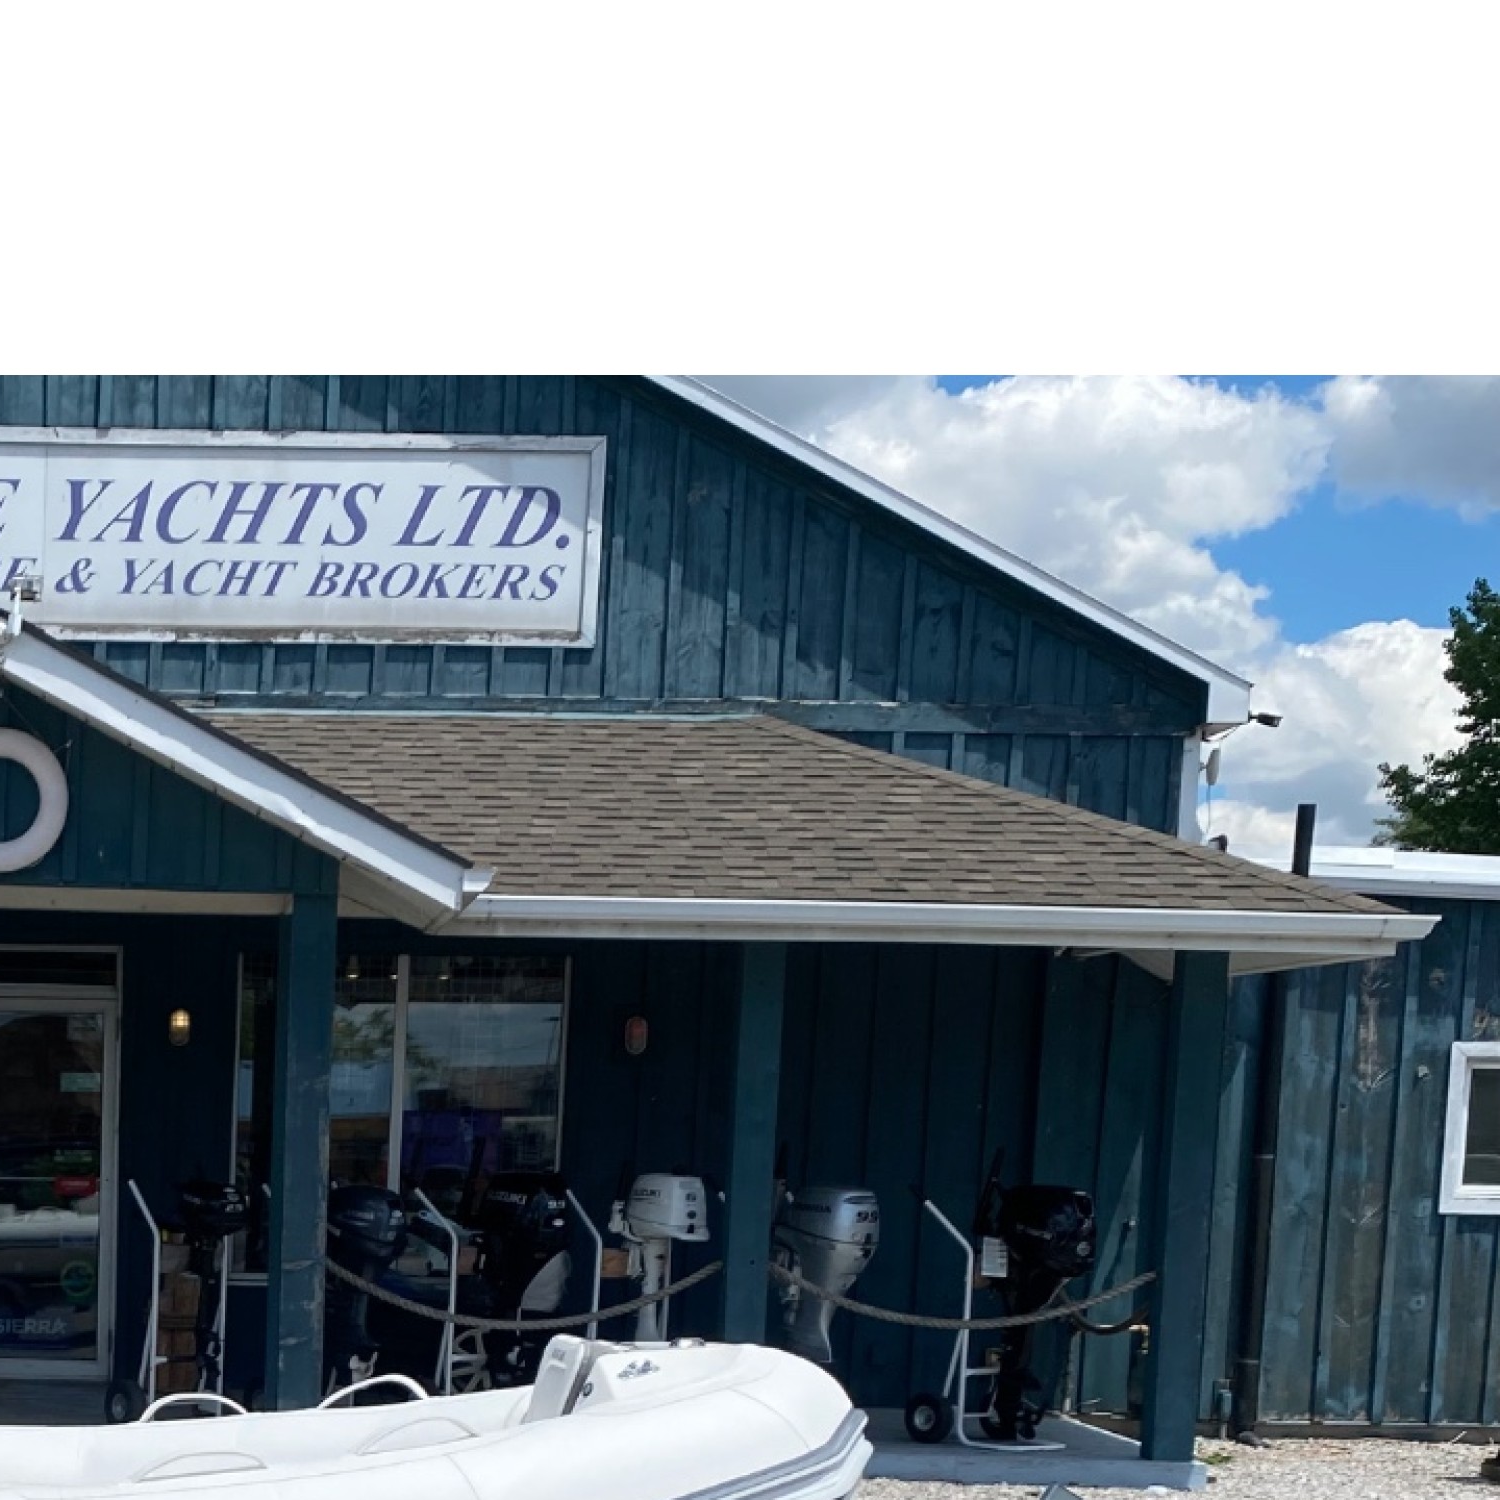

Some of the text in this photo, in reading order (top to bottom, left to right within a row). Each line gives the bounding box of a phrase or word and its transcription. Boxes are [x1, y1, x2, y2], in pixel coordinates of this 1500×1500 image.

[52, 479, 385, 546] YACHTS
[392, 485, 570, 549] LTD.
[54, 557, 97, 594] &
[117, 558, 298, 597] YACHT
[306, 562, 566, 601] BROKERS
